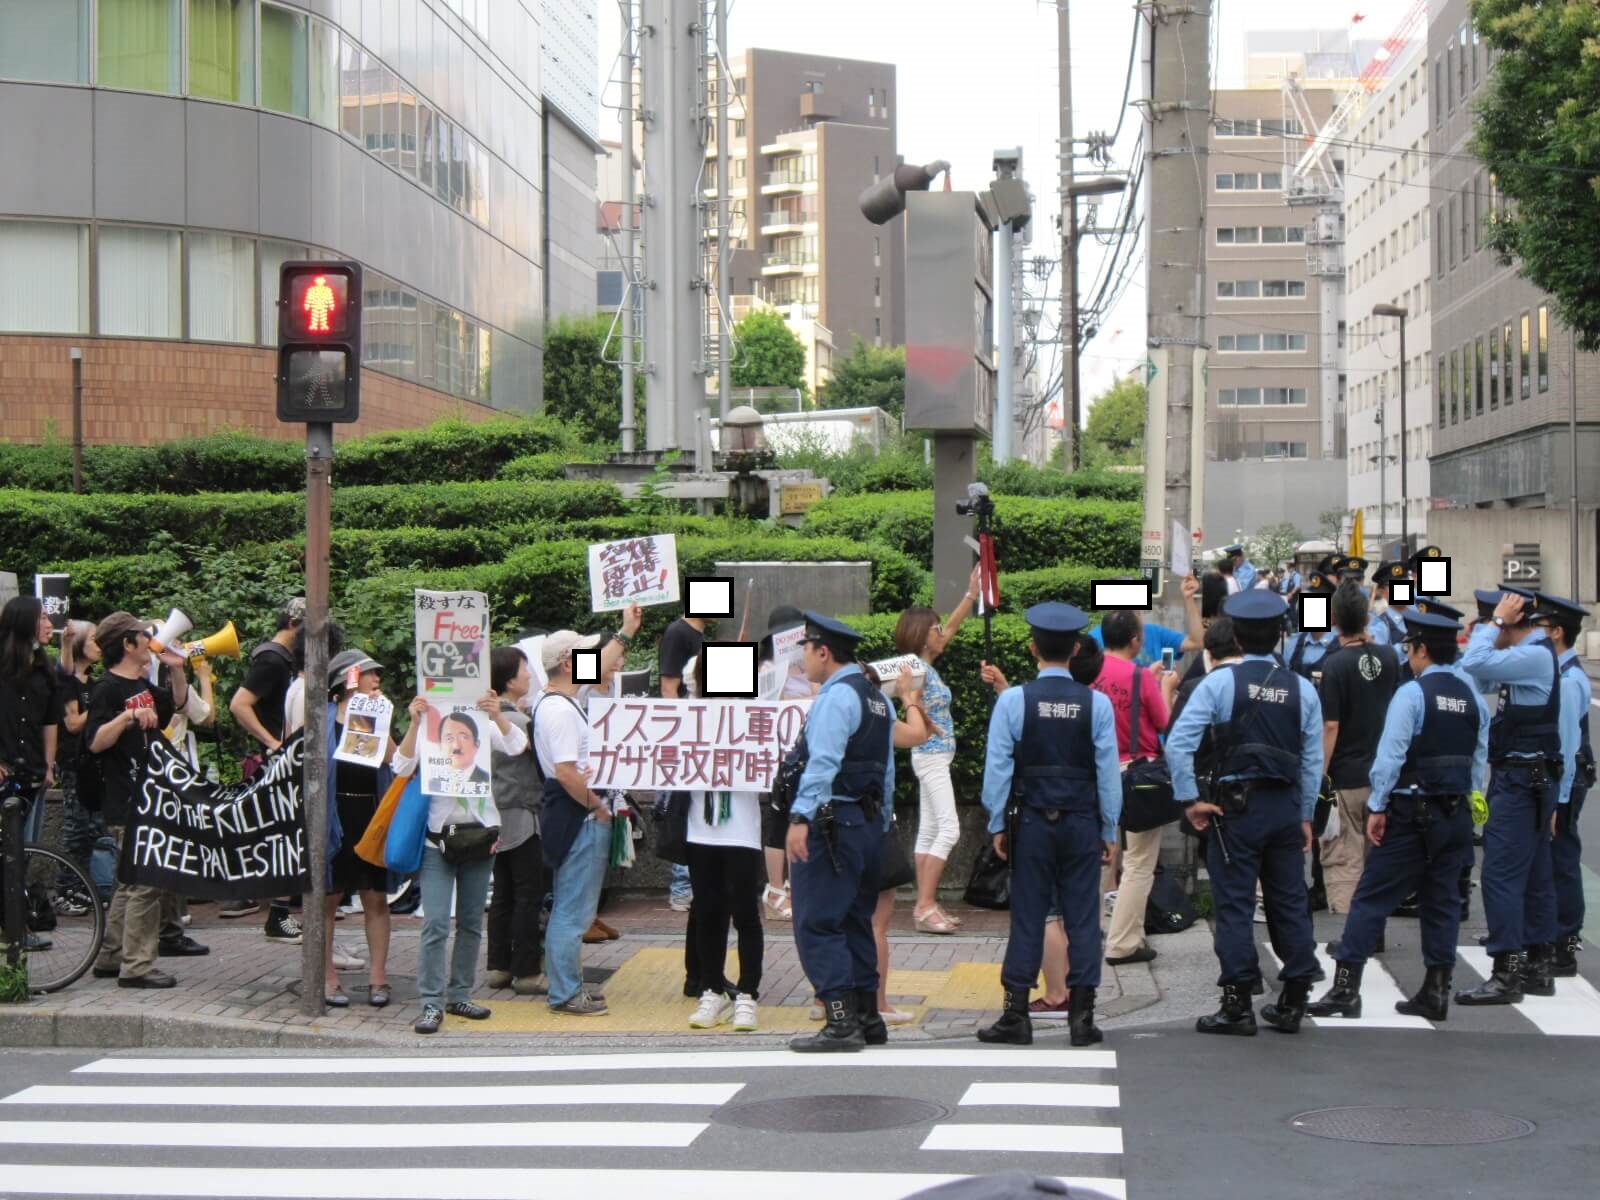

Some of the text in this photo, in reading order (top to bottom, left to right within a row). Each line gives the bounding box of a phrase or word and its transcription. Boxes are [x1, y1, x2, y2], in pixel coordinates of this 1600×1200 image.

[600, 537, 660, 568] 空爆
[602, 558, 660, 584] 即時
[1508, 560, 1520, 579] P
[877, 658, 921, 676] BOMNG
[1247, 683, 1289, 704] 警視庁
[1436, 695, 1467, 713] 警視庁
[1037, 701, 1081, 719] 警視庁
[592, 703, 806, 746] イスラエル軍の
[137, 779, 182, 825] STOP
[183, 803, 214, 831] THE
[134, 825, 199, 876] FREE
